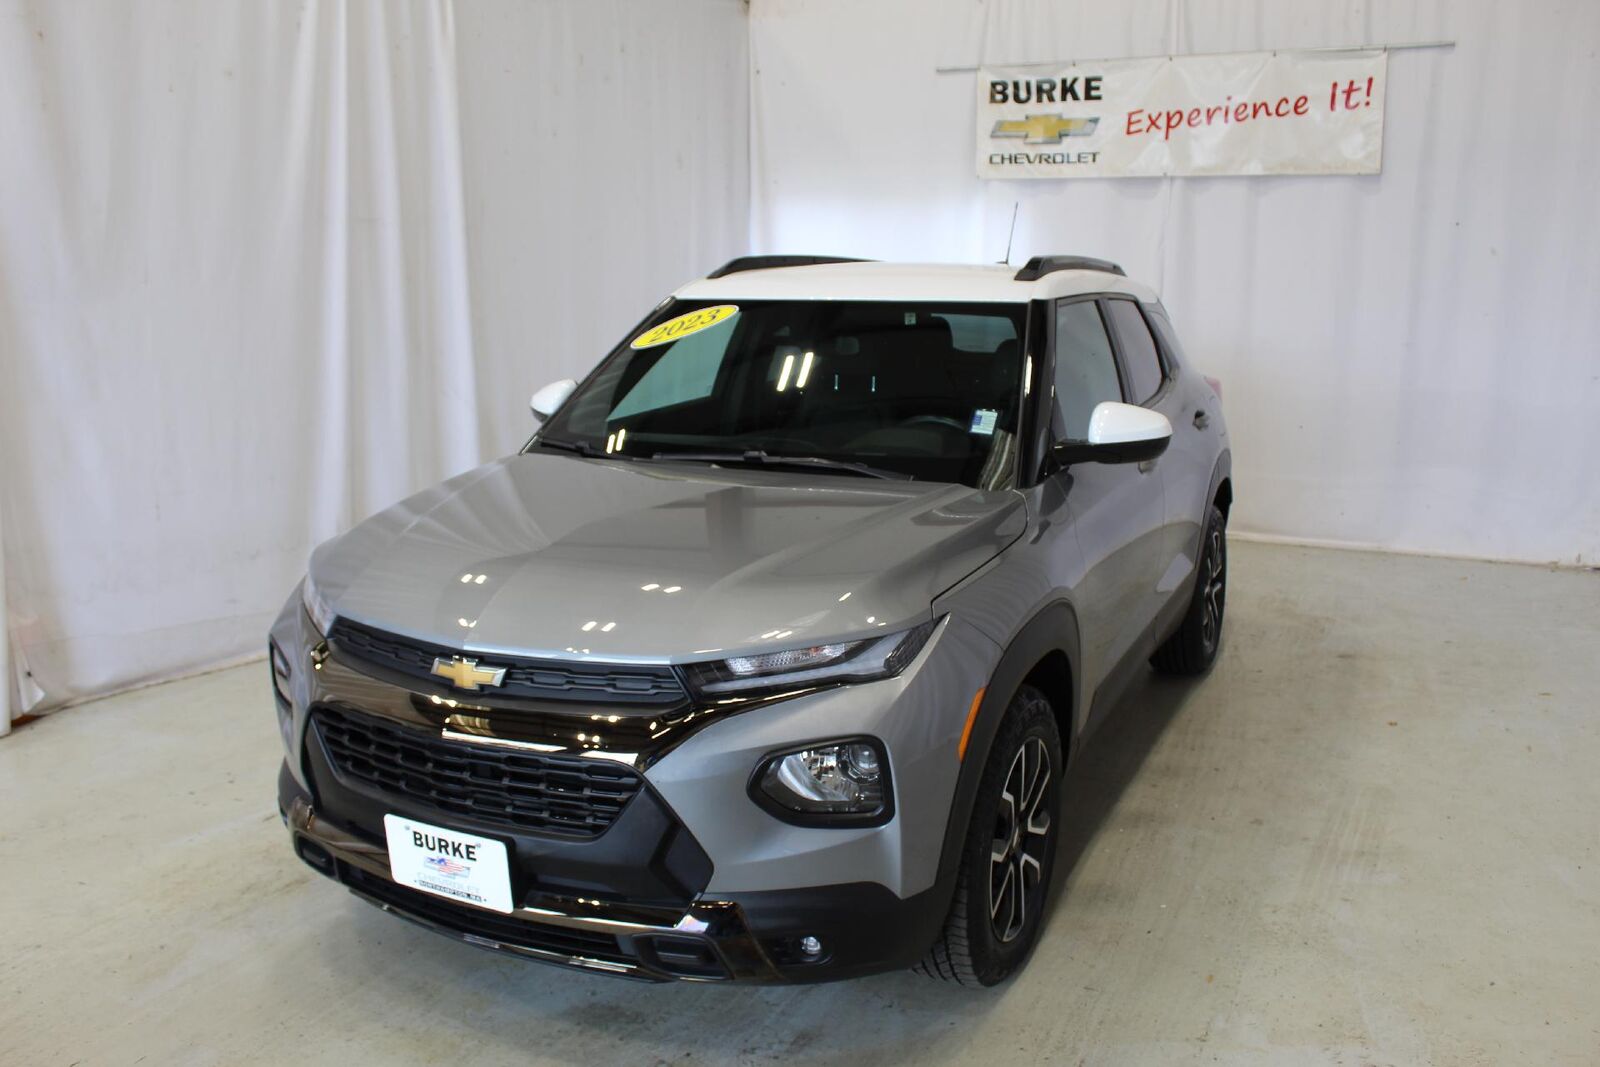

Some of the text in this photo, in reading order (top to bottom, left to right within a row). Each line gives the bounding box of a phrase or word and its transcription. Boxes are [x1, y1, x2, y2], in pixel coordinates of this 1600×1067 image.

[989, 76, 1103, 104] BURKE
[1126, 77, 1373, 140] Experience It!
[989, 152, 1100, 165] CHEVROLET
[647, 308, 721, 344] 2023
[412, 830, 477, 862] BURKE
